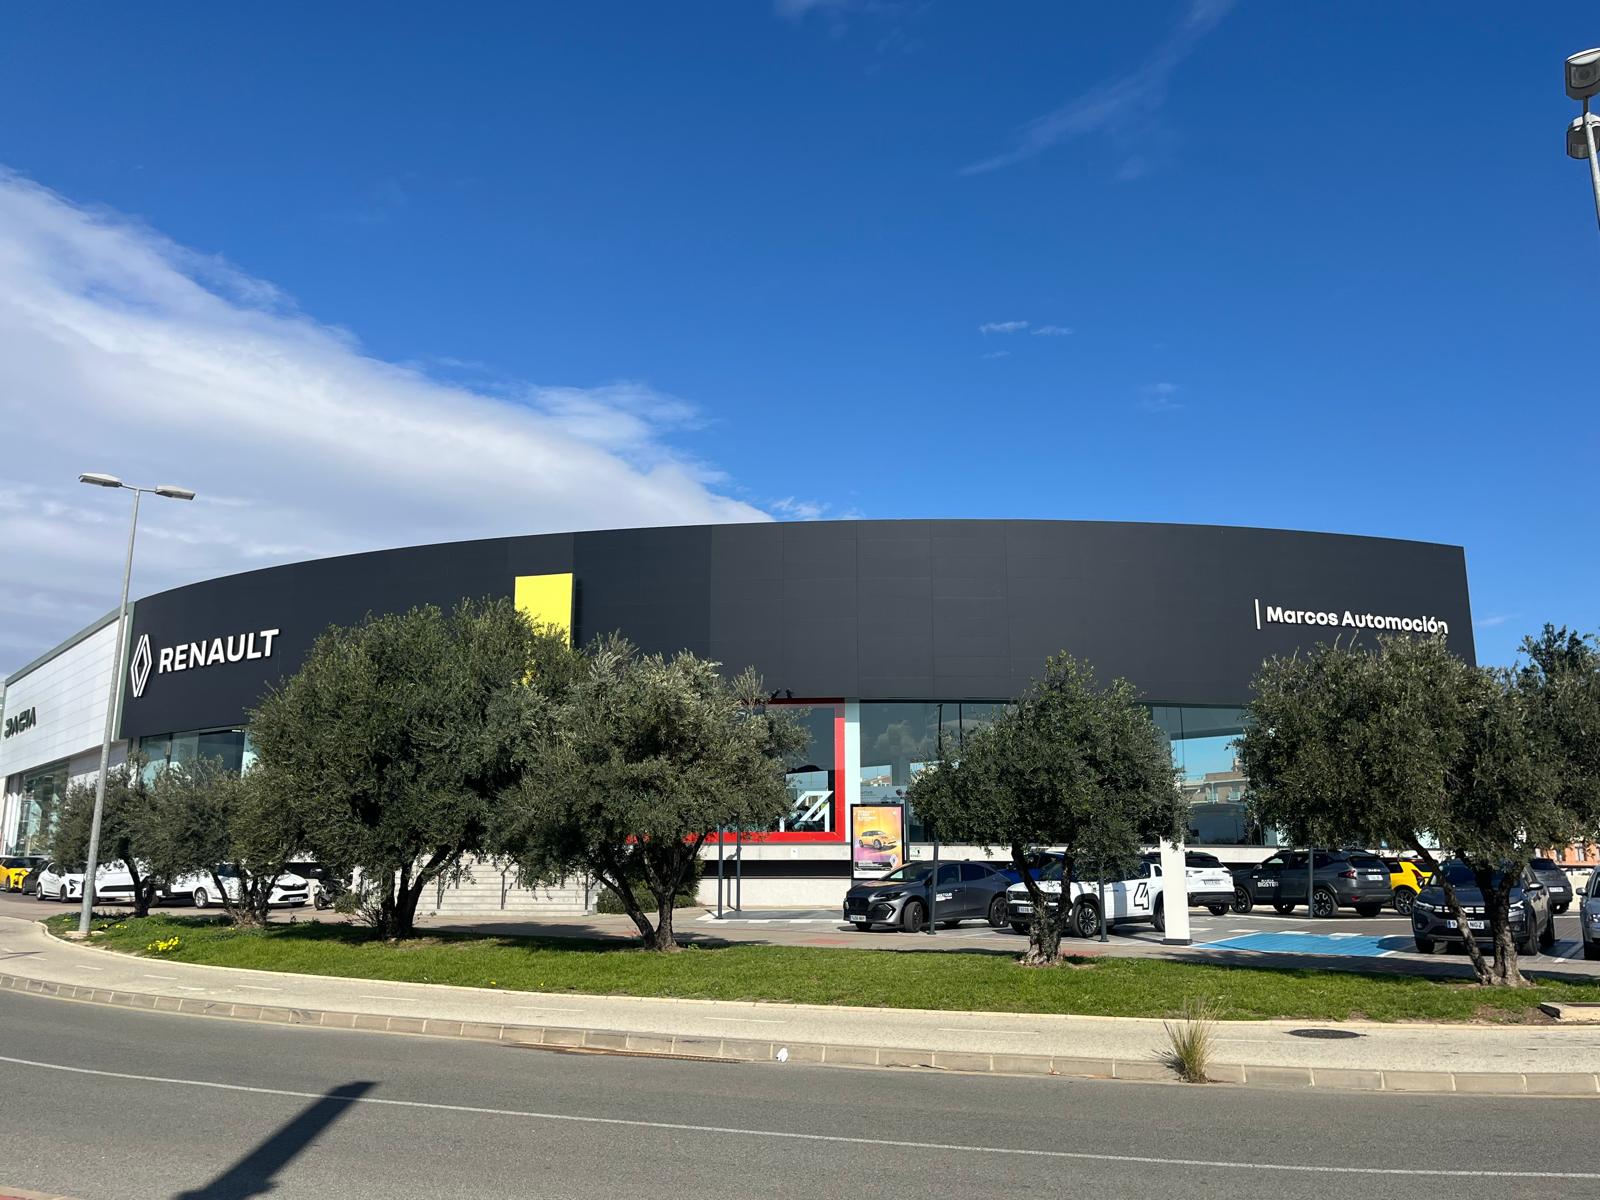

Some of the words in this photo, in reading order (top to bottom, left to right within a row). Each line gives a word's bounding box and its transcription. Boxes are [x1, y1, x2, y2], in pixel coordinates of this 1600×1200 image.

[1266, 606, 1338, 626] Marcos
[1342, 610, 1449, 634] Automoción
[158, 628, 280, 674] RENAULT
[4, 706, 37, 739] DACIA
